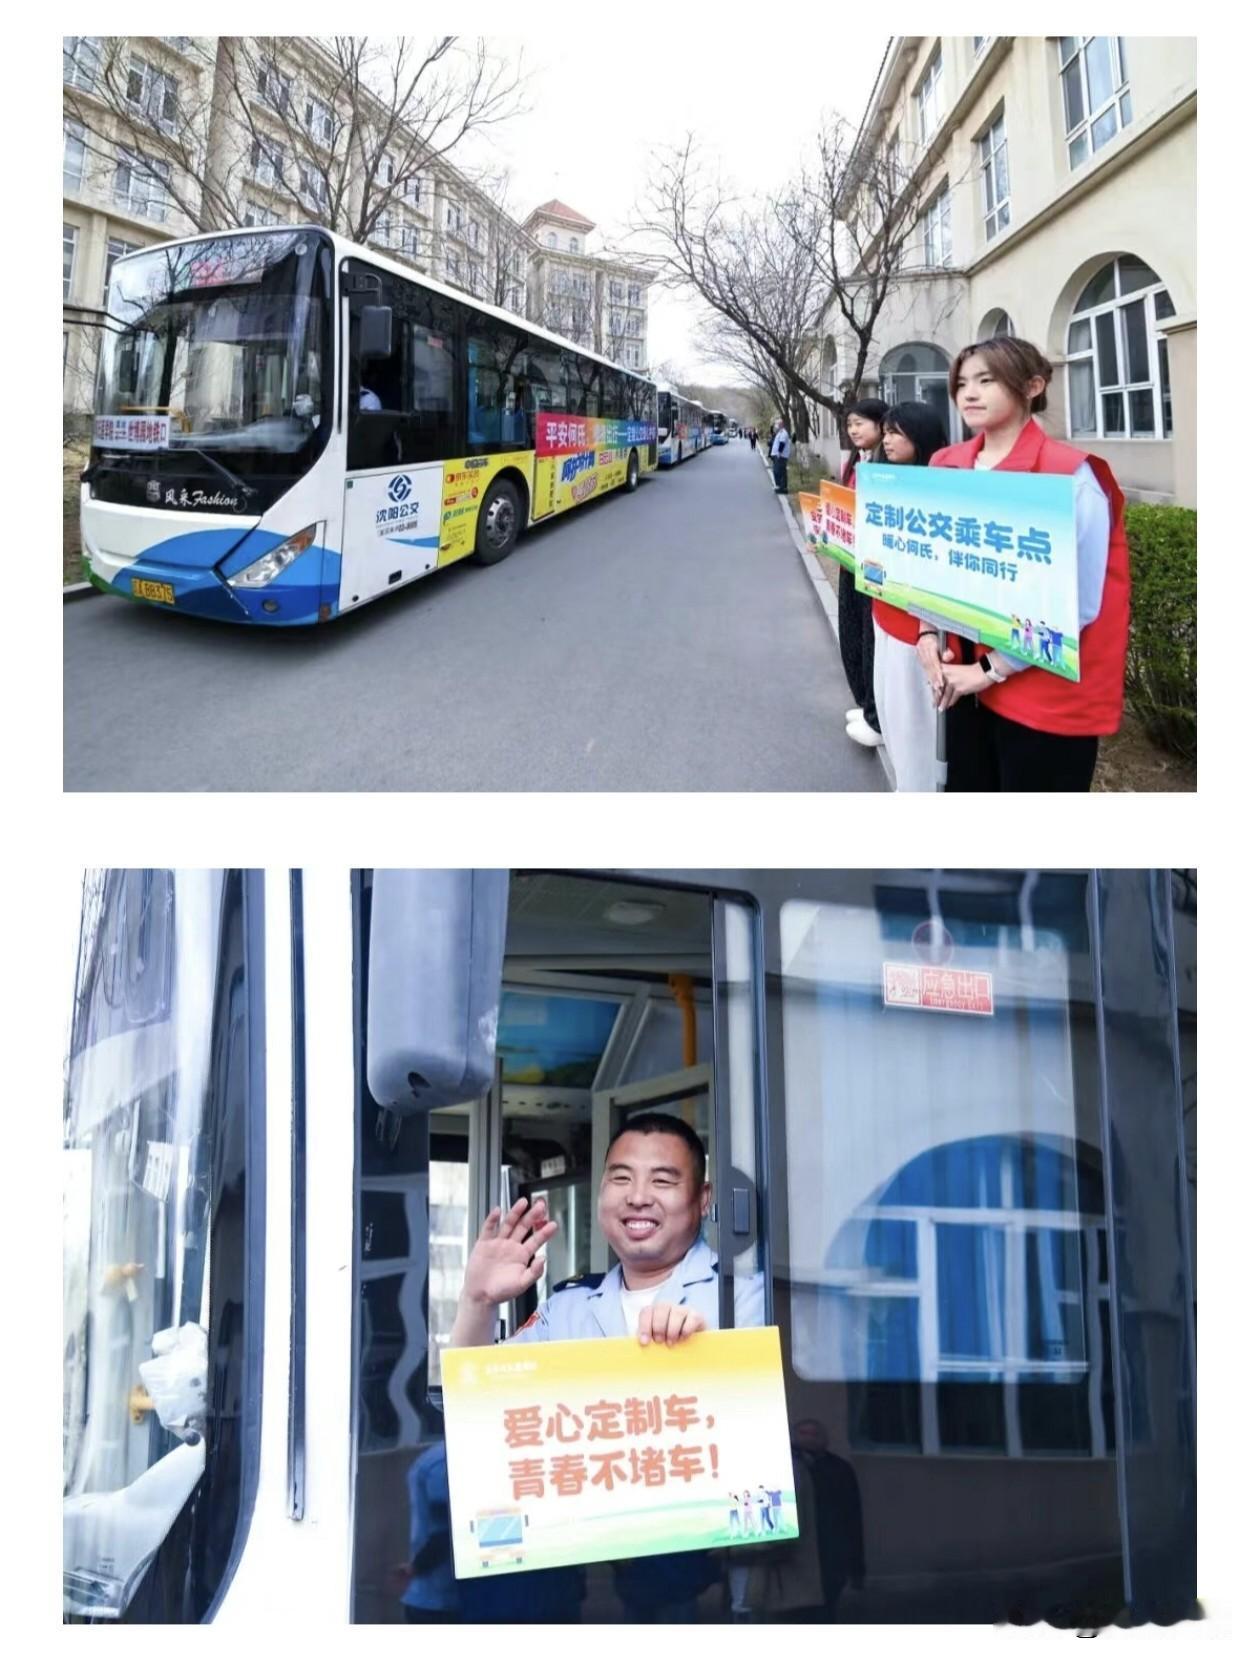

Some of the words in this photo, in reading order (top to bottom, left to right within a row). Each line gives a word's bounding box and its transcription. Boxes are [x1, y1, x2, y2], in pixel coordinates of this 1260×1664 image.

[165, 488, 192, 506] 风采
[192, 490, 238, 506] Fashion
[376, 501, 420, 524] 沈阳公交
[865, 501, 1052, 565] 定制公交乘车点
[882, 533, 1018, 582] 暖心何氏，伴你同行
[922, 970, 990, 1001] 应急出口
[503, 1394, 716, 1448] 爱心定制车，
[508, 1443, 719, 1500] 青春不堵车！
